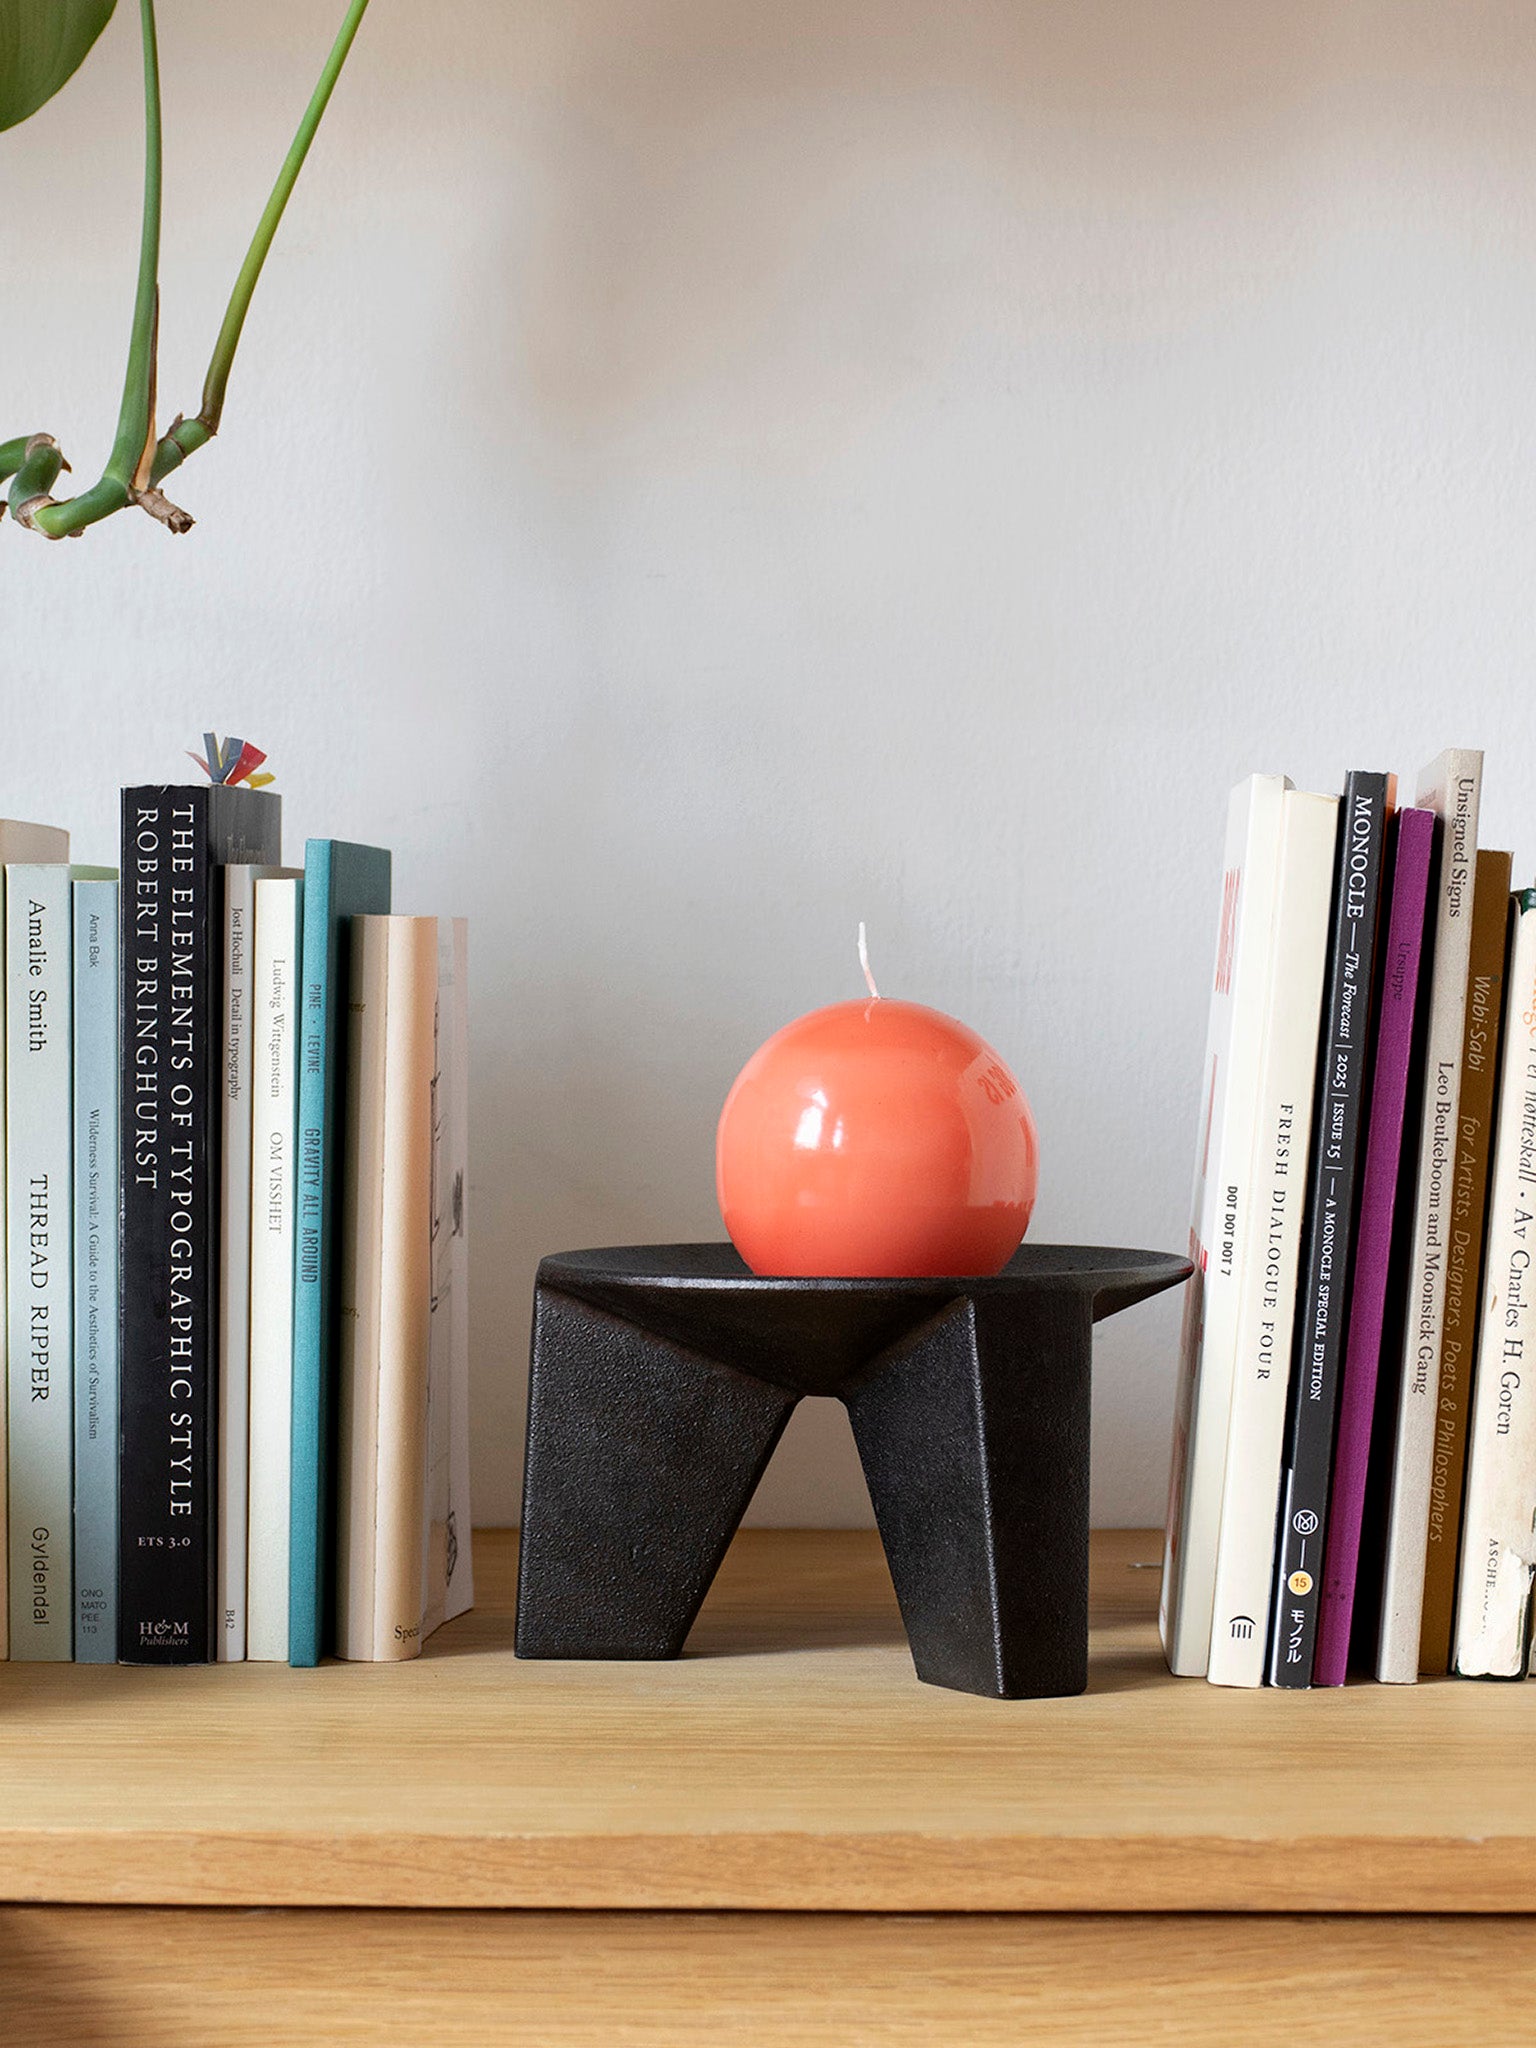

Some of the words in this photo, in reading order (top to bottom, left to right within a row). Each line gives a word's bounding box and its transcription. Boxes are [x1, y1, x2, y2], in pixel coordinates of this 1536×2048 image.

[172, 804, 194, 873] THE
[1451, 778, 1474, 863] Unsigned
[137, 807, 159, 943] ROBERT
[1346, 794, 1372, 918] MONOCLE
[1446, 868, 1467, 918] Signs
[29, 899, 47, 976] Amalie
[90, 913, 100, 942] Anna
[231, 907, 244, 929] Jost
[90, 945, 100, 968] Bak
[231, 930, 244, 975] Hochuli
[1344, 953, 1360, 979] The
[1391, 943, 1411, 1001] Ursuppe
[171, 887, 194, 1071] ELEMENTS
[269, 959, 286, 1008] Ludwig
[309, 983, 322, 1010] PINE
[30, 989, 47, 1053] Smith
[230, 1024, 242, 1035] in
[231, 988, 243, 1022] Detail
[1340, 981, 1357, 1038] Forecast
[1467, 975, 1491, 1072] Wabi-Sabi
[136, 957, 158, 1189] BRINGHURST
[227, 1038, 241, 1101] typography
[268, 1013, 285, 1098] Wittgenstein
[307, 1034, 321, 1074] LEVINE
[1333, 1054, 1348, 1089] 2025
[1437, 1061, 1454, 1095] Leo
[171, 1084, 193, 1127] OF
[1331, 1102, 1345, 1140] ISSUE
[89, 1108, 100, 1169] Wilderness
[269, 1131, 283, 1161] OM
[1274, 1103, 1293, 1177] FRESH
[1327, 1143, 1341, 1159] 15
[1429, 1101, 1452, 1208] Beukeboom
[1460, 1115, 1480, 1147] for
[304, 1128, 321, 1187] GRAVITY
[89, 1171, 100, 1219] Survival:
[302, 1193, 319, 1219] ALL
[1225, 1185, 1238, 1210] DOT
[1325, 1198, 1337, 1207] A
[1453, 1150, 1477, 1221] Artists,
[31, 1173, 48, 1289] THREAD
[1223, 1213, 1236, 1237] DOT
[1320, 1212, 1336, 1281] MONOCLE
[1426, 1213, 1442, 1247] and
[1513, 1207, 1534, 1239] Av
[89, 1234, 100, 1267] Guide
[171, 1140, 193, 1399] TYPOGRAPHIC
[301, 1227, 318, 1283] AROUND
[1220, 1269, 1231, 1277] 7
[1221, 1241, 1233, 1265] DOT
[1263, 1189, 1286, 1309] DIALOGUE
[89, 1270, 99, 1282] to
[89, 1284, 99, 1301] the
[1419, 1252, 1441, 1341] Moonsick
[1444, 1229, 1471, 1331] Designers,
[89, 1304, 99, 1361] Aesthetics
[1315, 1285, 1330, 1339] SPECIAL
[31, 1304, 49, 1403] RIPPER
[89, 1363, 99, 1376] of
[1257, 1321, 1275, 1381] FOUR
[1309, 1343, 1325, 1400] EDITION
[1411, 1346, 1434, 1395] Gang
[1441, 1340, 1462, 1390] Poets
[1502, 1338, 1524, 1363] H.
[89, 1377, 100, 1440] Survivalism
[1440, 1396, 1458, 1412] &
[1496, 1371, 1521, 1436] Goren
[170, 1412, 193, 1517] STYLE
[1428, 1419, 1456, 1542] Philosophers
[138, 1536, 164, 1547] ETS
[168, 1536, 191, 1549] 3.0
[31, 1527, 50, 1625] Gyldendal
[81, 1589, 103, 1598] ONO
[1294, 1577, 1307, 1588] 15
[81, 1601, 107, 1610] MATO
[81, 1613, 100, 1622] PEE
[139, 1619, 189, 1636] H&M
[225, 1609, 236, 1630] B42
[139, 1635, 190, 1647] Publishers
[1287, 1609, 1306, 1663] モノクル
